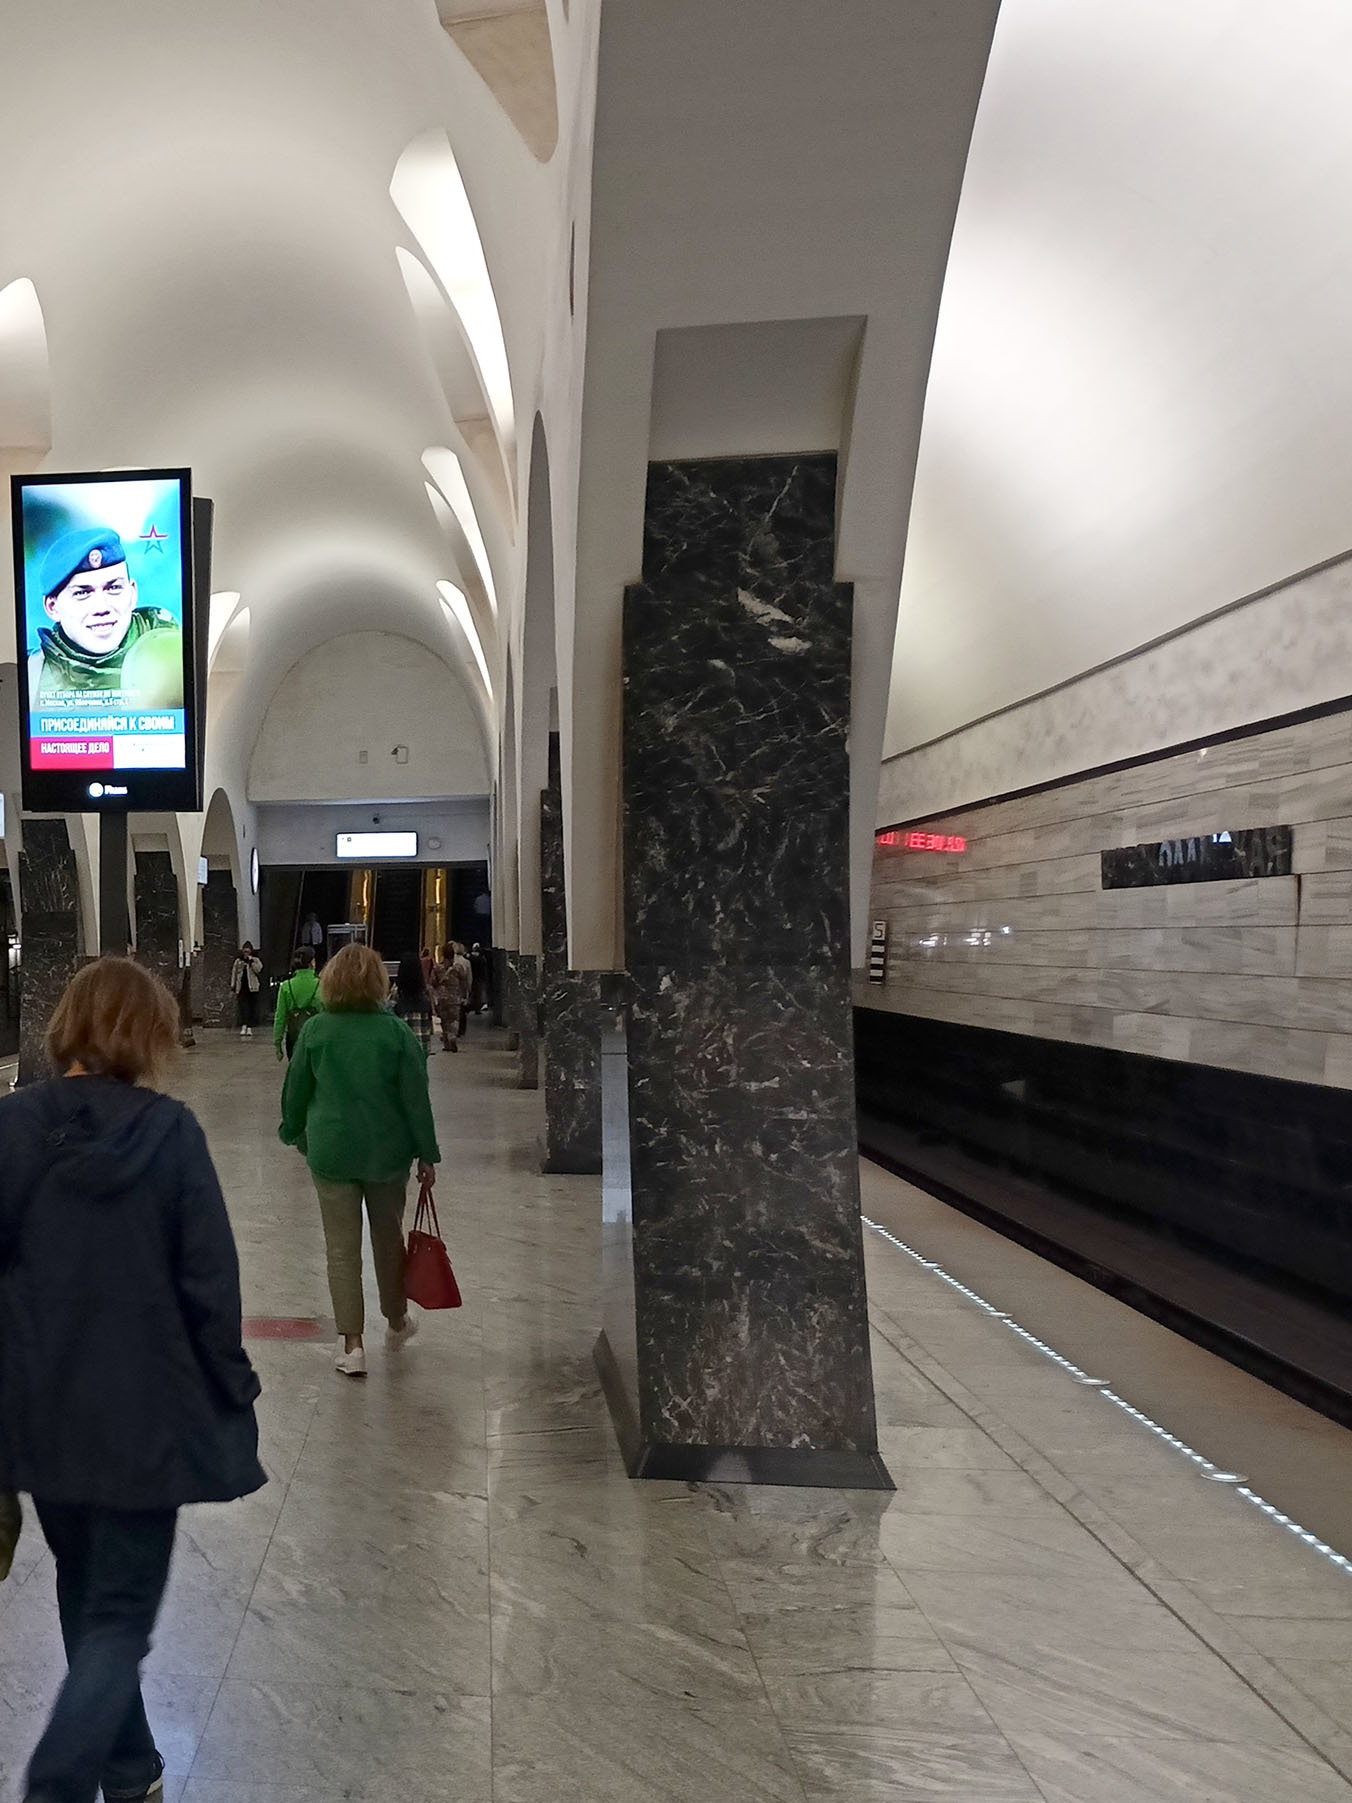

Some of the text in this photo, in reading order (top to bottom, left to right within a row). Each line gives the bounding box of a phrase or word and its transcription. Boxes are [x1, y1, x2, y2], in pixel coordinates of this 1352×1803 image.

[41, 716, 175, 732] ПРИСОЕДИНЯЙСЯ К СВОИМ
[41, 742, 110, 754] НАСТОЯЩЕЕ ДЕЛО
